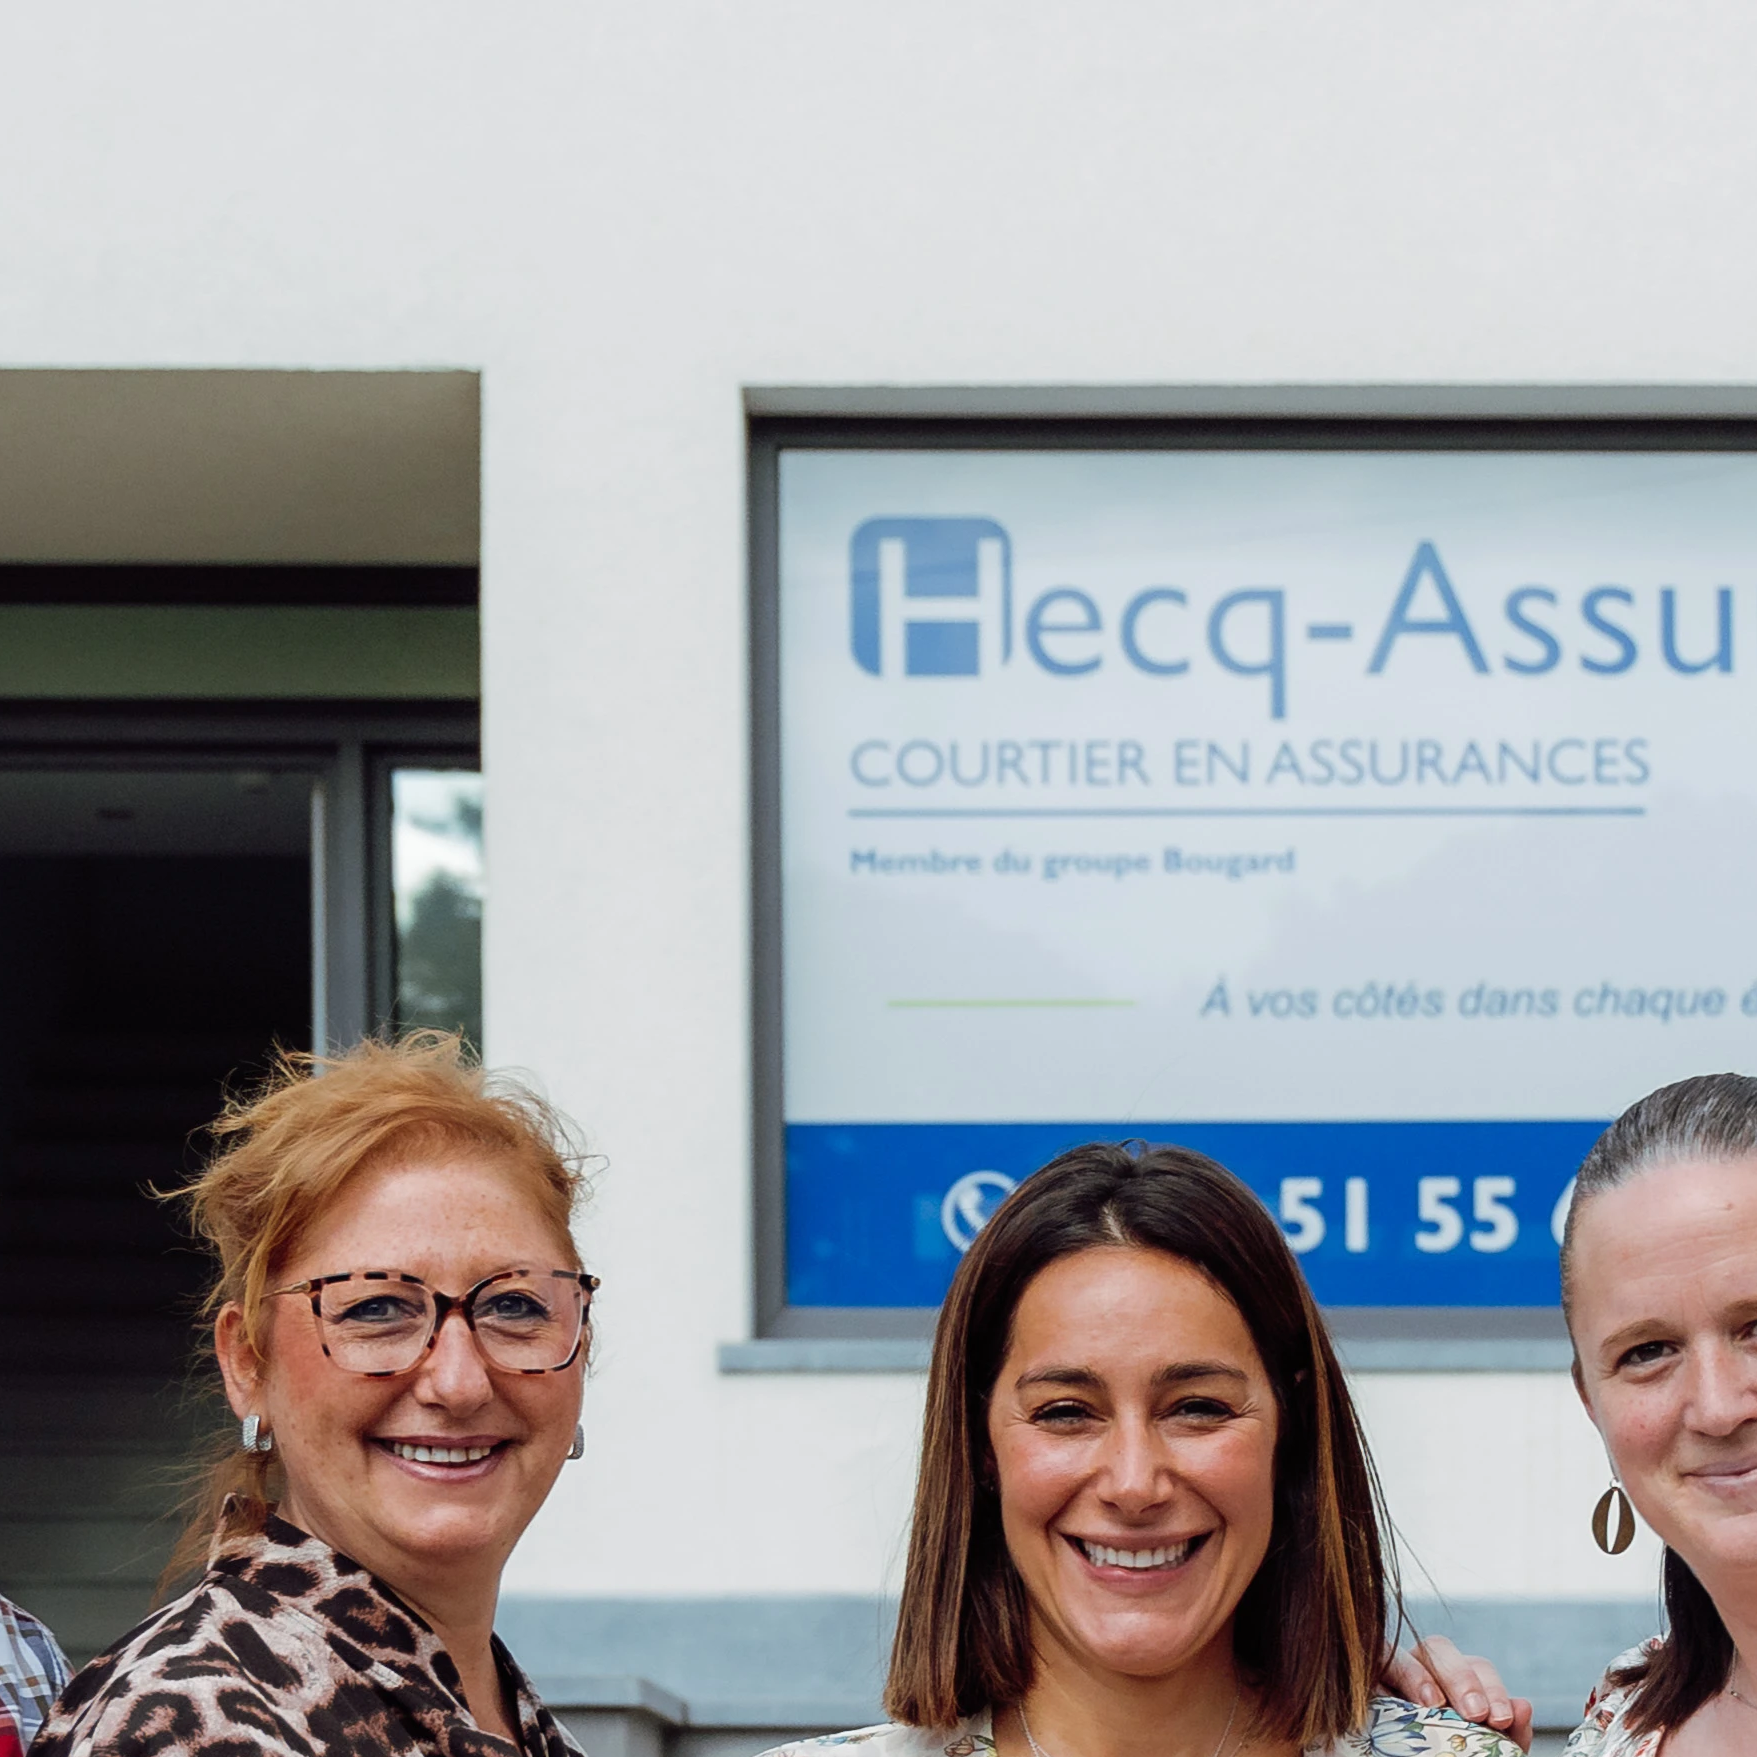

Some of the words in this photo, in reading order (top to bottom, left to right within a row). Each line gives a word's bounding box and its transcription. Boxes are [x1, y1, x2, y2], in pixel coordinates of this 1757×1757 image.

[848, 738, 1151, 788] COURTIER
[1173, 738, 1251, 787] EN
[1265, 737, 1651, 787] ASSURANCES
[848, 847, 982, 875] Membre
[991, 847, 1033, 875] du
[1041, 852, 1152, 883] groupe
[1162, 846, 1296, 882] Bougard
[1247, 988, 1320, 1019] vos
[1331, 979, 1446, 1019] côtés
[1456, 980, 1561, 1019] dans
[1572, 980, 1729, 1025] chaque
[1279, 1176, 1369, 1253] 51
[1414, 1176, 1519, 1253] 55
